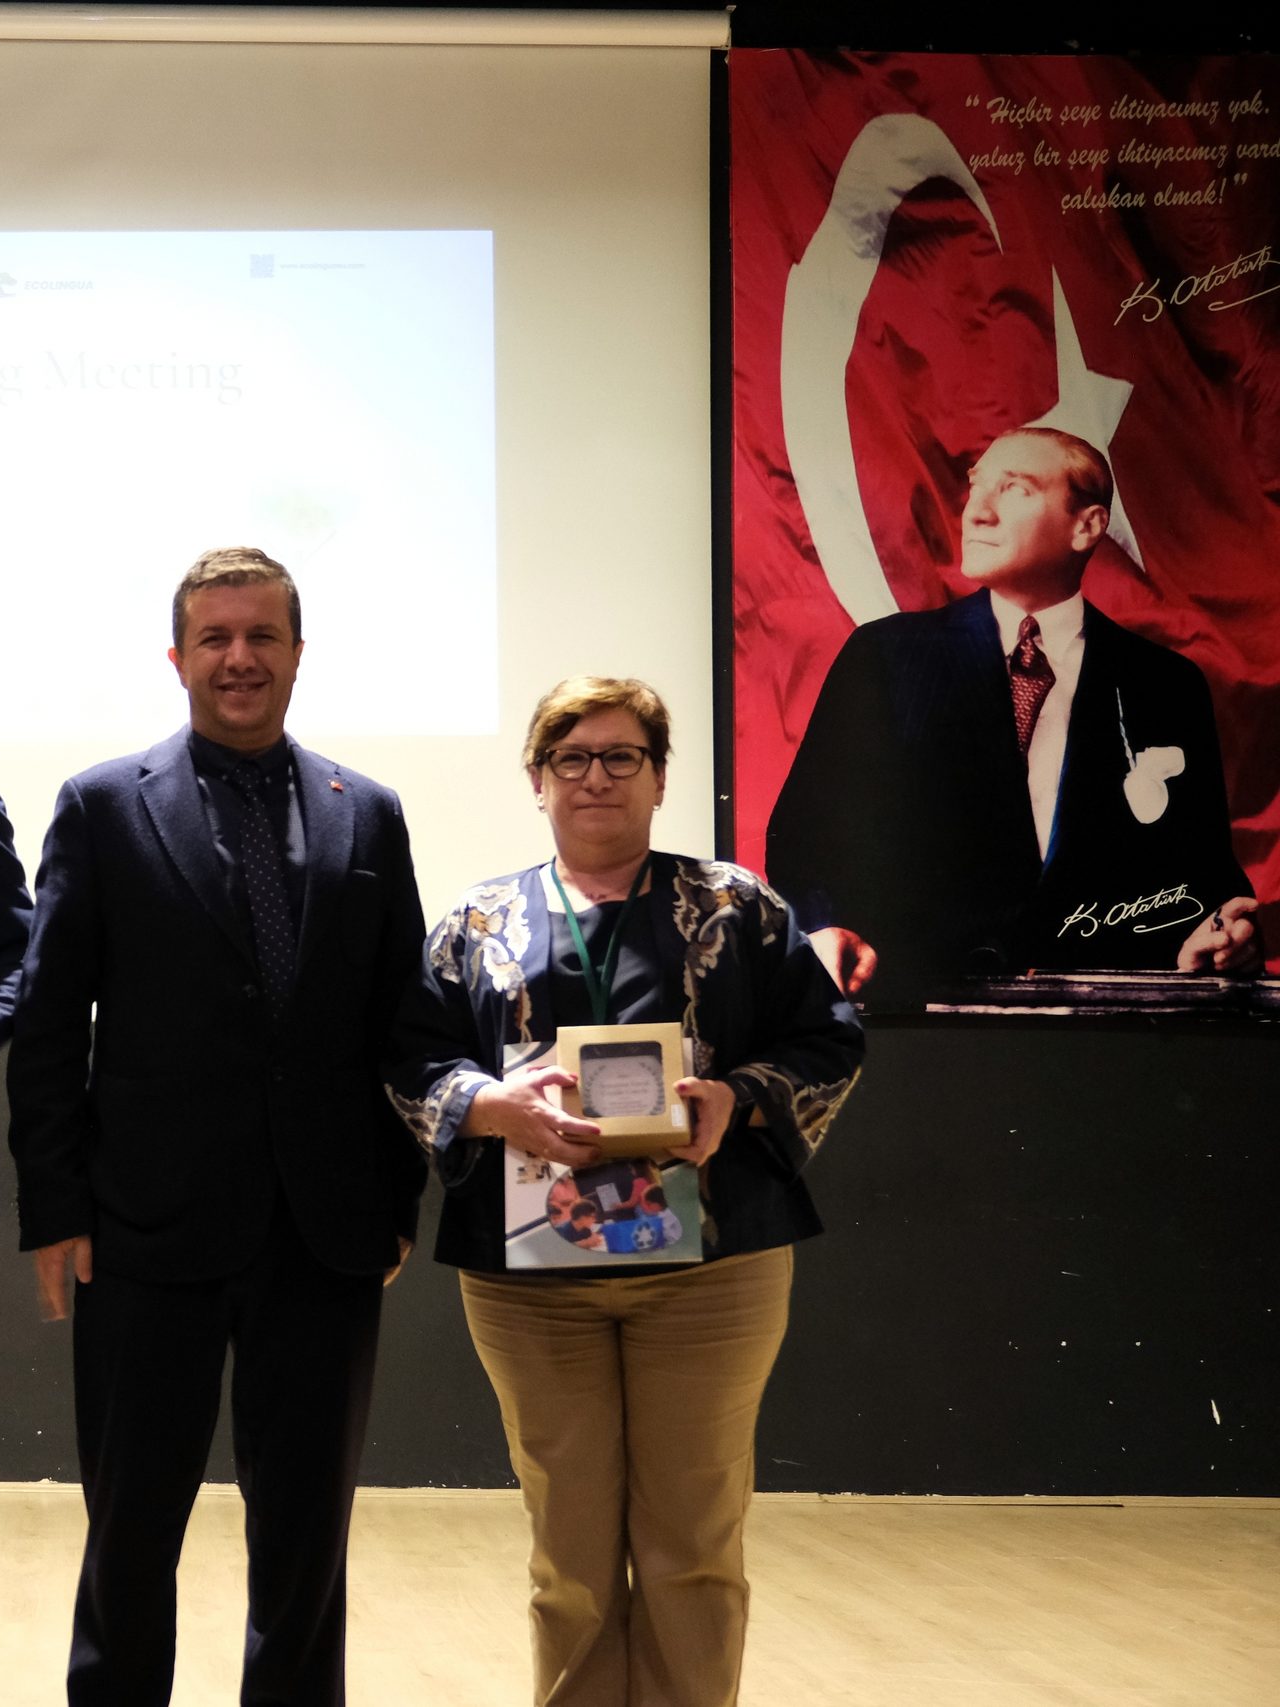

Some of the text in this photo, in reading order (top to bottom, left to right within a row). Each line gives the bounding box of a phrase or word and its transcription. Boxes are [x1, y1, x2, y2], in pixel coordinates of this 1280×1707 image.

[1060, 106, 1102, 126] şeye
[1110, 94, 1220, 125] ihtiyacımız
[1228, 89, 1270, 123] yok.
[969, 146, 1026, 175] yalnız
[1034, 140, 1061, 166] bir
[1068, 150, 1110, 171] şeye
[1117, 138, 1229, 168] ihtiyacımız
[1061, 183, 1146, 215] çalışkan
[24, 280, 94, 290] ECOLINGUA
[43, 350, 245, 405] Meeting
